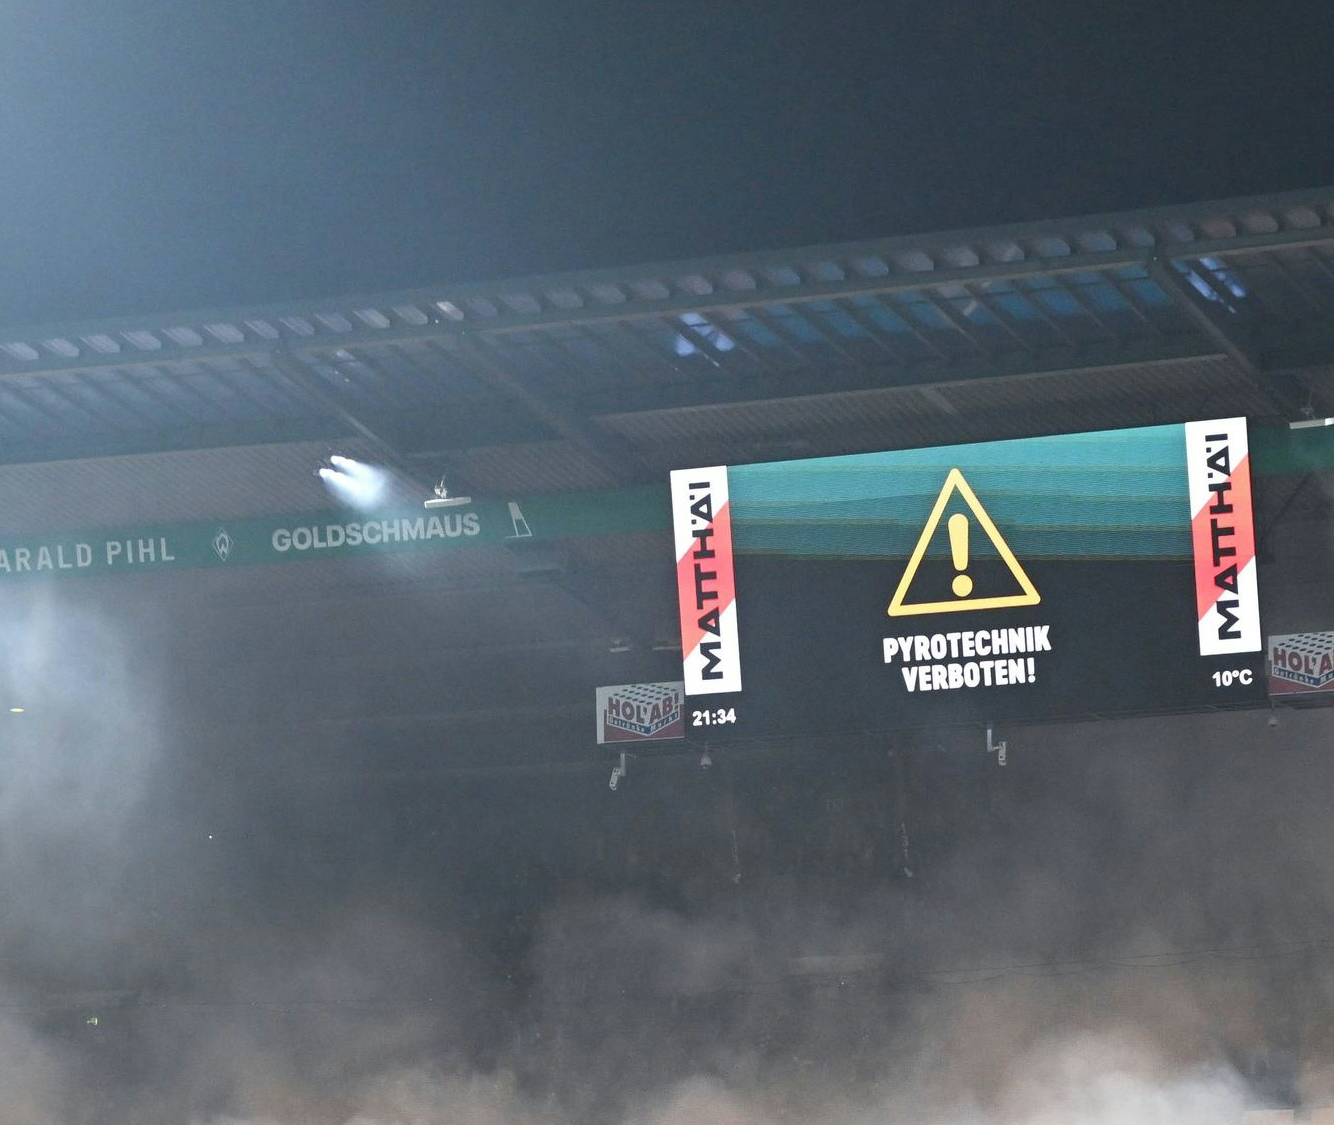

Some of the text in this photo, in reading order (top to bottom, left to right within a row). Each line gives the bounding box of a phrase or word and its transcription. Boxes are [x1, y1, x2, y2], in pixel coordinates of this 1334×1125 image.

[106, 537, 176, 565] PIHL
[271, 512, 481, 552] GOLDSCHMAUS
[1205, 433, 1242, 640] MATTHÄI
[688, 481, 724, 681] MATTHÄI
[882, 625, 1052, 664] PYROTECHNIK
[901, 657, 1036, 693] VERBOTEN!
[692, 708, 737, 726] 21:34
